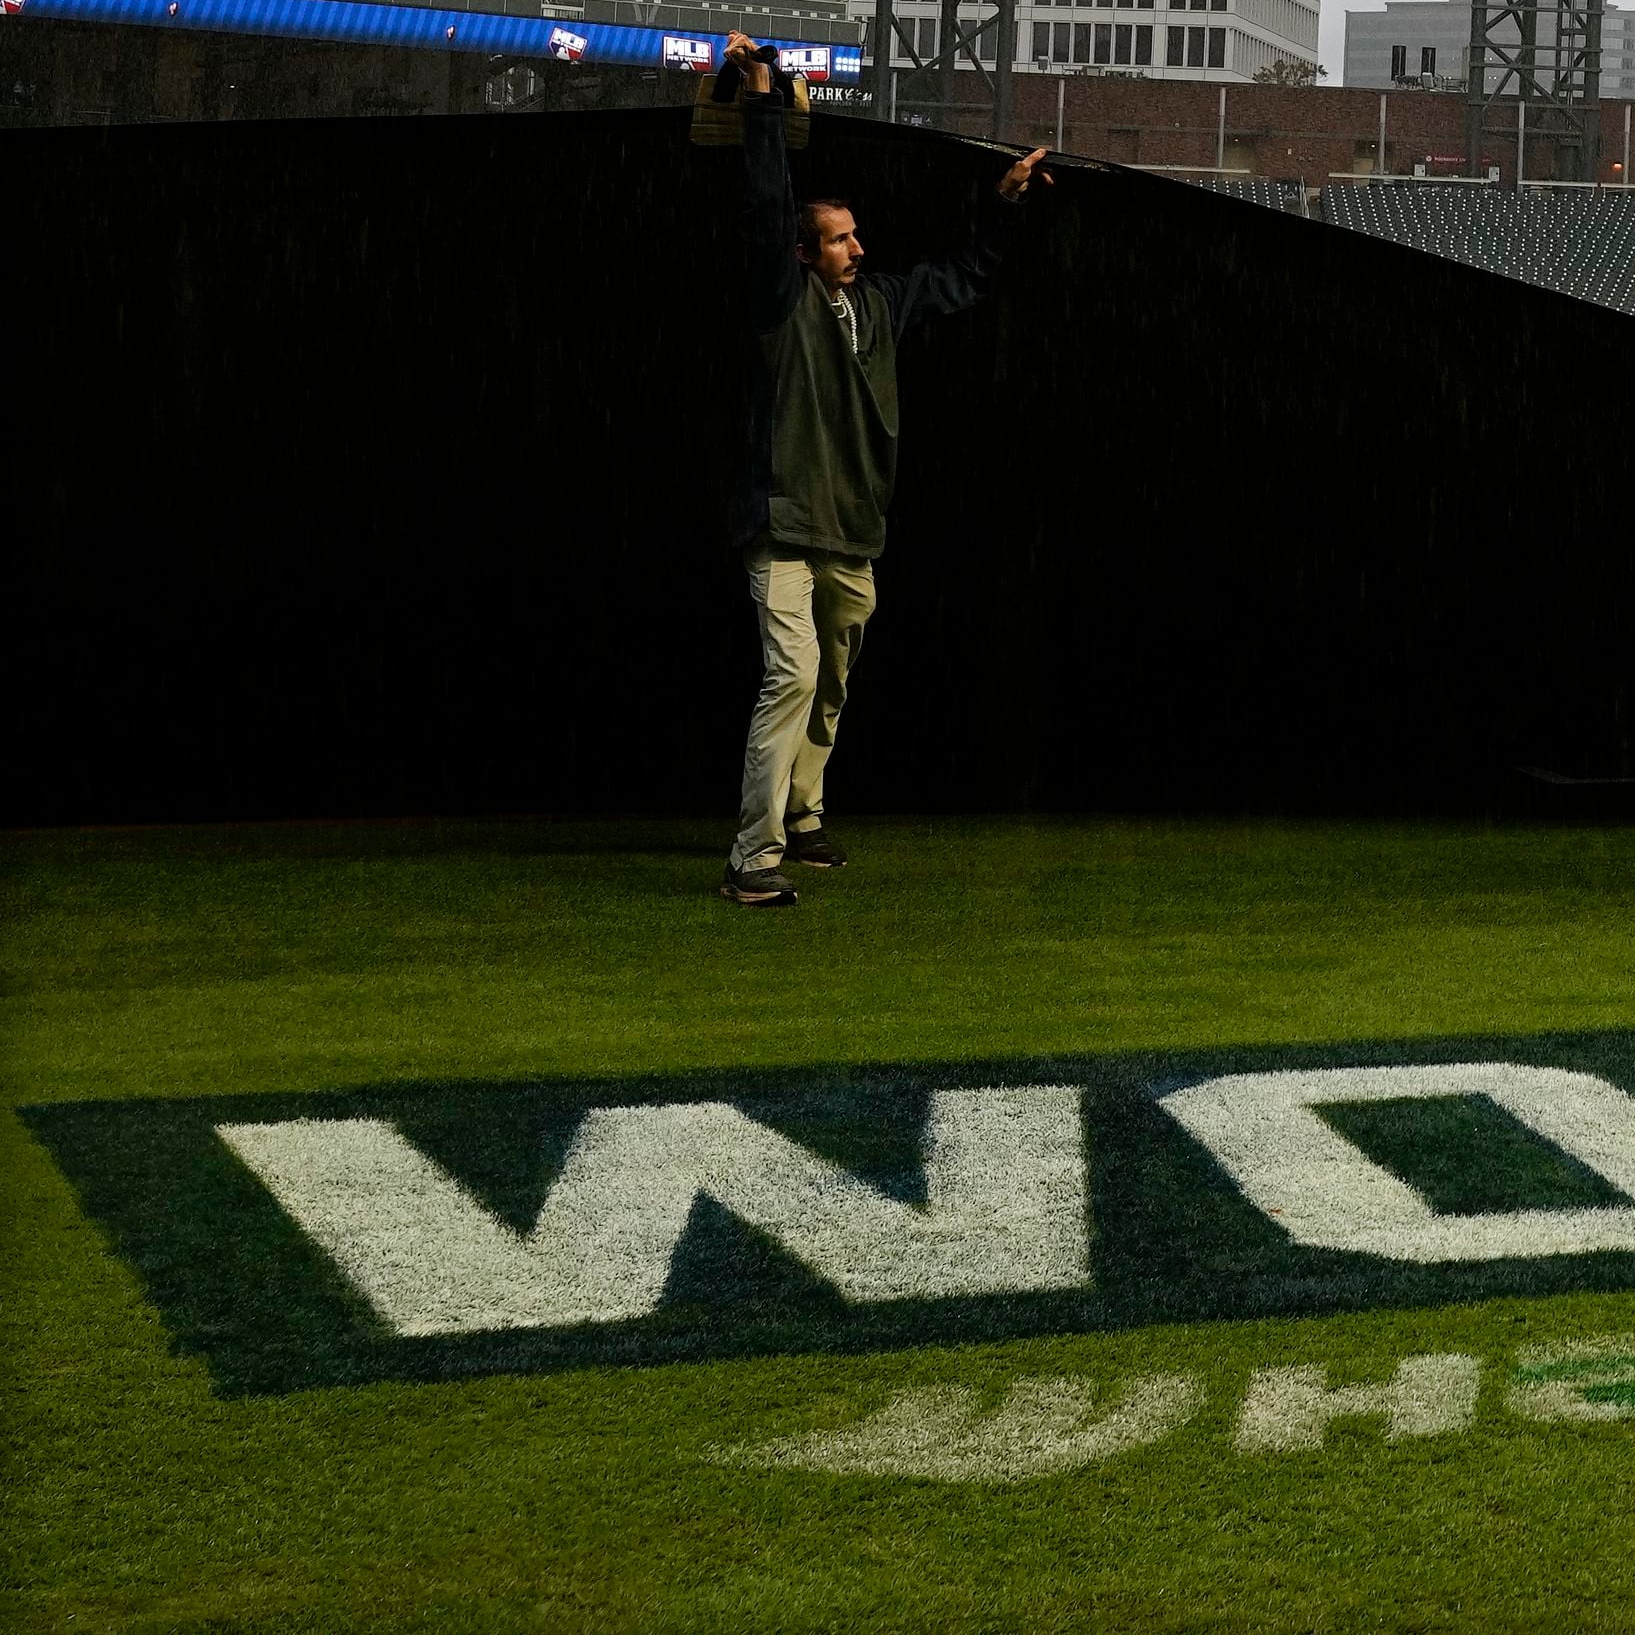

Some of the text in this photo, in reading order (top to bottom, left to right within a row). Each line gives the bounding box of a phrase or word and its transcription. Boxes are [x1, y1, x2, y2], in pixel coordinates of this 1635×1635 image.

[666, 37, 710, 57] MLB
[666, 54, 710, 64] NETWORK
[781, 49, 827, 68] MLB
[781, 65, 827, 73] NETWORK
